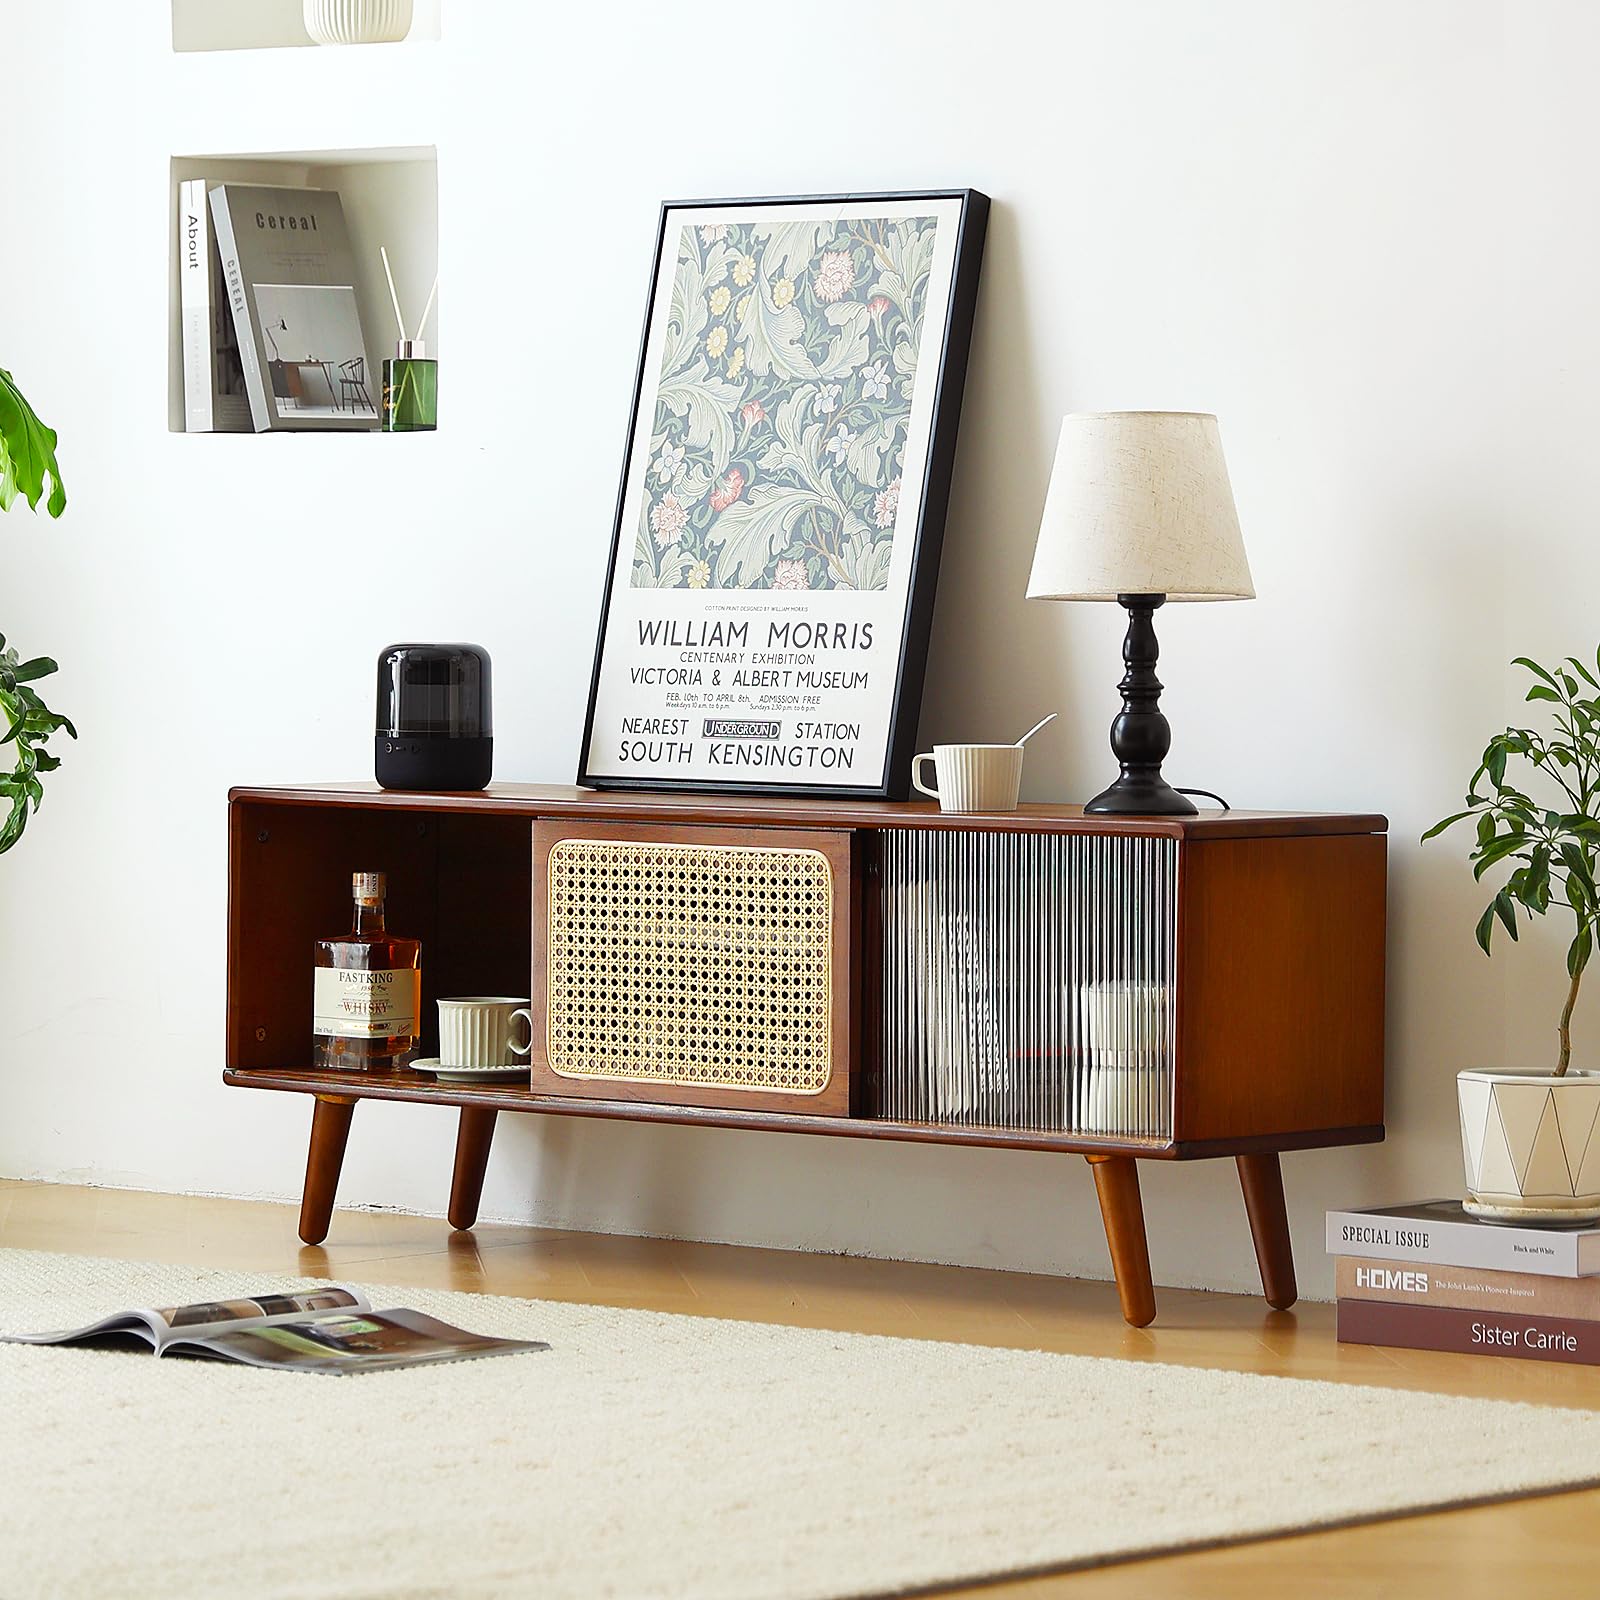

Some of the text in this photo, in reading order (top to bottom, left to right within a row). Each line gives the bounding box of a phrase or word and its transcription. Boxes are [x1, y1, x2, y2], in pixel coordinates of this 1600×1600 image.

[255, 212, 318, 231] Cereal
[187, 214, 199, 269] About
[227, 259, 244, 313] CEREAL
[638, 620, 873, 650] WILLIAM MORRIS
[680, 651, 815, 665] CENTENARY EXHIBITION
[630, 667, 868, 689] VICTORIA & ALBERT MUSEUM
[665, 701, 691, 710] Weekdays
[703, 693, 714, 702] TO
[716, 693, 735, 702] APRIL
[758, 694, 800, 704] ADMISSION
[802, 695, 821, 704] FREE
[750, 703, 770, 712] Sundays
[621, 718, 861, 740] NEAREST UNDERGROUND STATION
[618, 740, 854, 768] SOUTH KENSINGTON
[339, 971, 393, 984] FASTKING
[343, 1001, 388, 1014] WHISKY
[1342, 1225, 1430, 1249] SPECIAL ISSUE
[1539, 1247, 1555, 1255] White
[1356, 1267, 1429, 1293] HOMES
[1435, 1280, 1447, 1289] The
[1447, 1281, 1462, 1290] John
[1471, 1323, 1578, 1352] Sister Carrie
